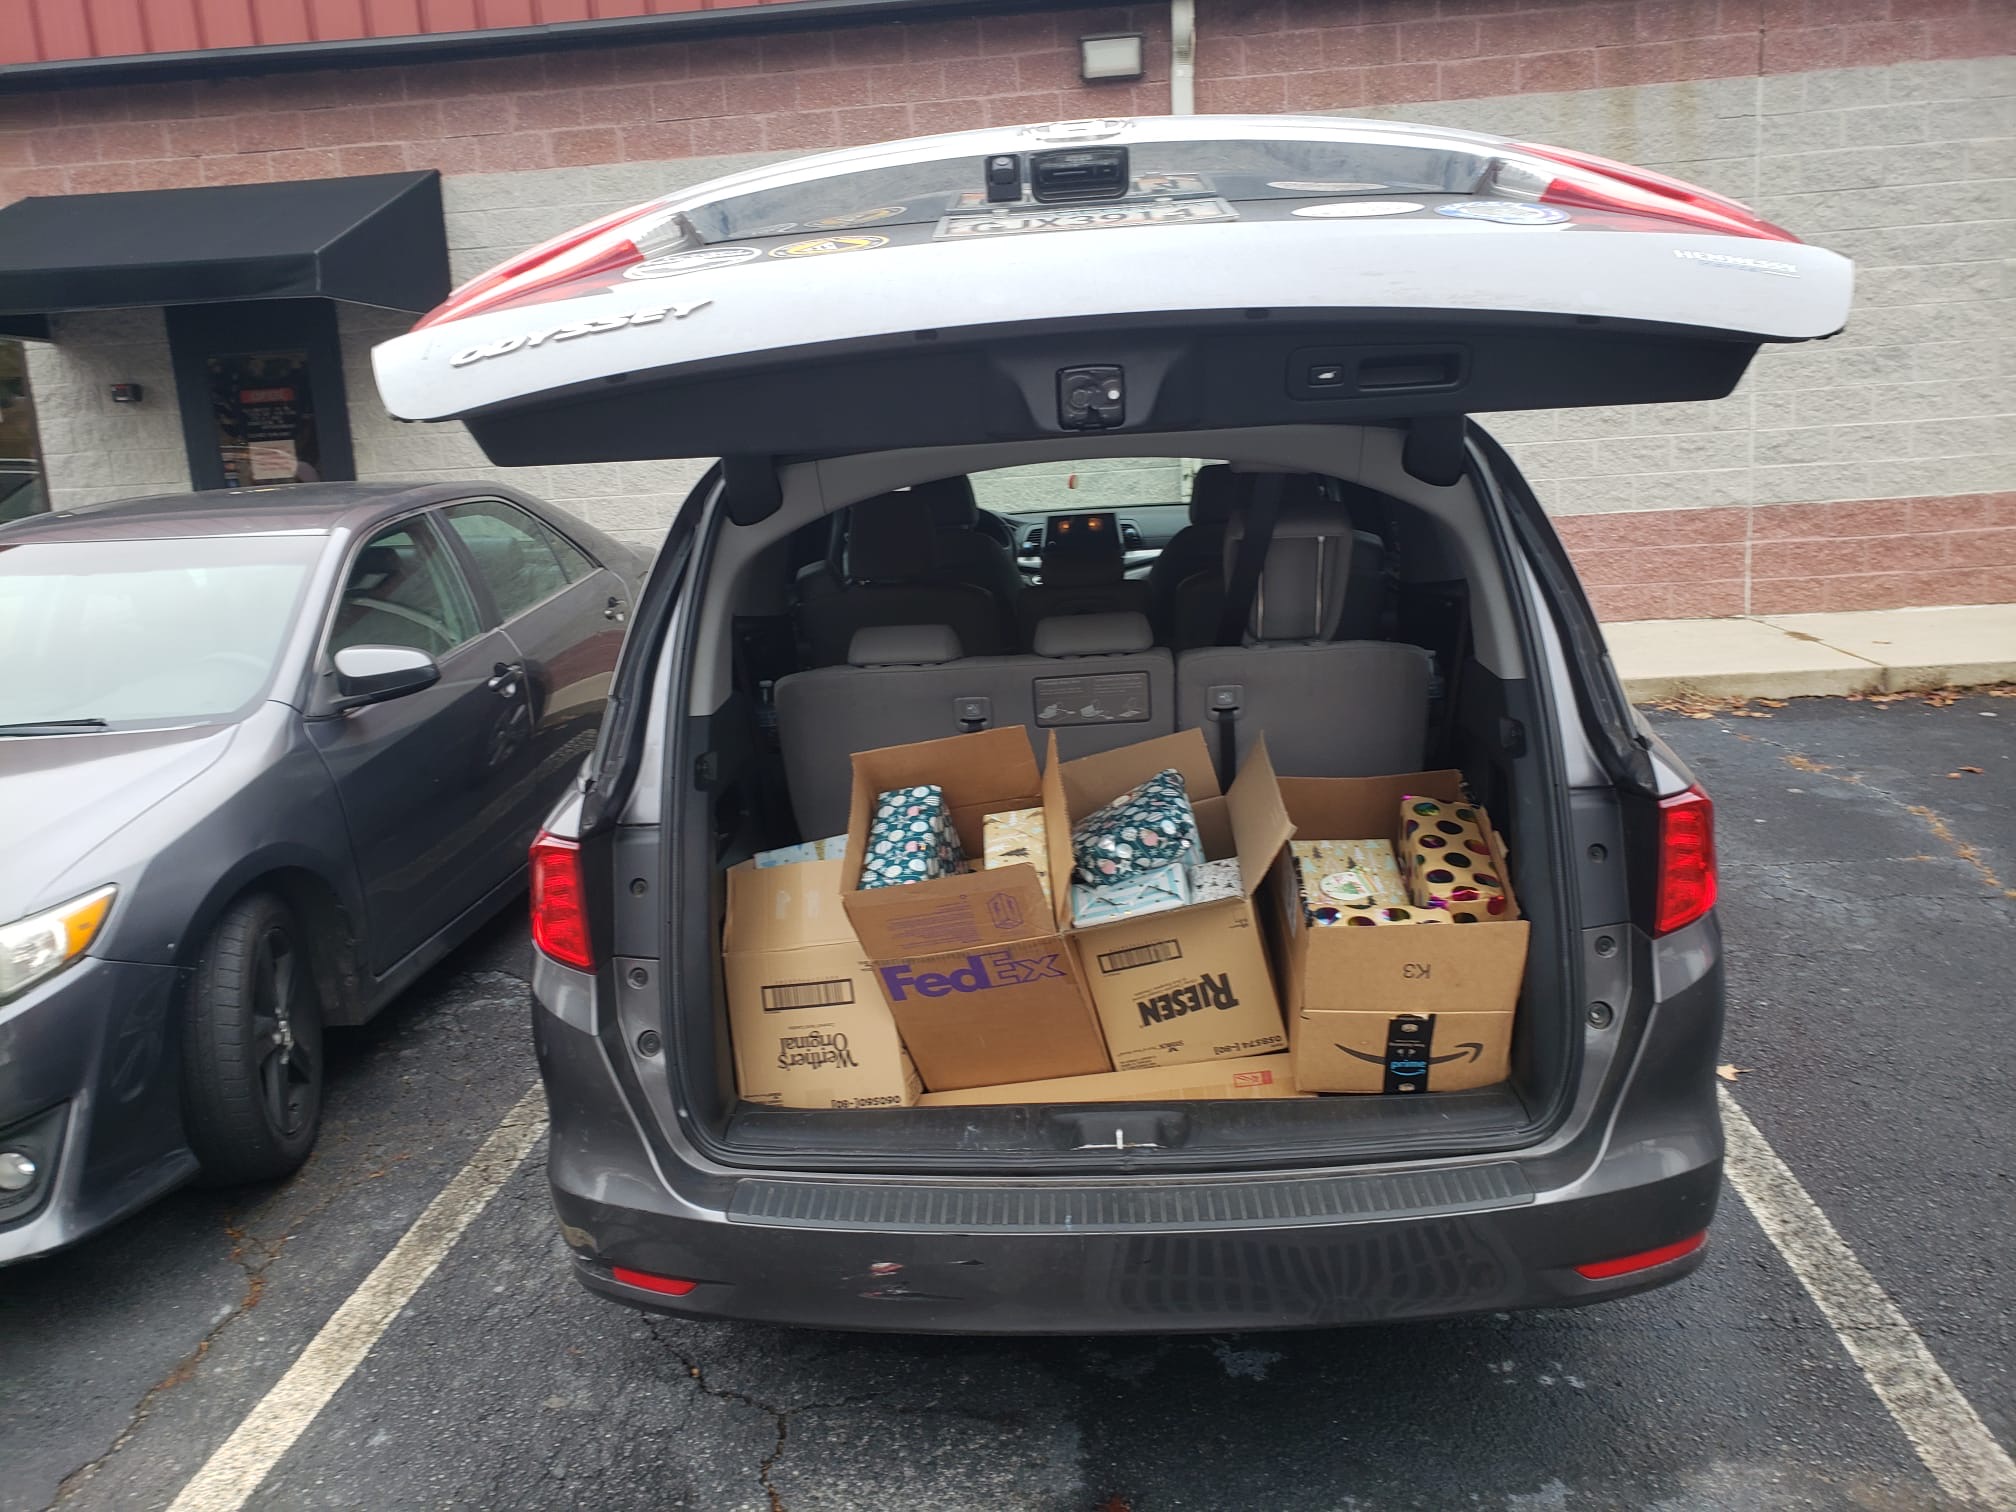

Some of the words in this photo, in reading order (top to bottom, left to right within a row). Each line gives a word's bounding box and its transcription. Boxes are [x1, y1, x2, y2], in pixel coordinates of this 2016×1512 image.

[449, 299, 714, 368] ODYSSEY
[879, 950, 1067, 1002] FedEx
[1402, 962, 1432, 980] K3
[1137, 972, 1240, 1028] RIESEN
[777, 1048, 858, 1072] Werther's
[779, 1031, 848, 1056] Original
